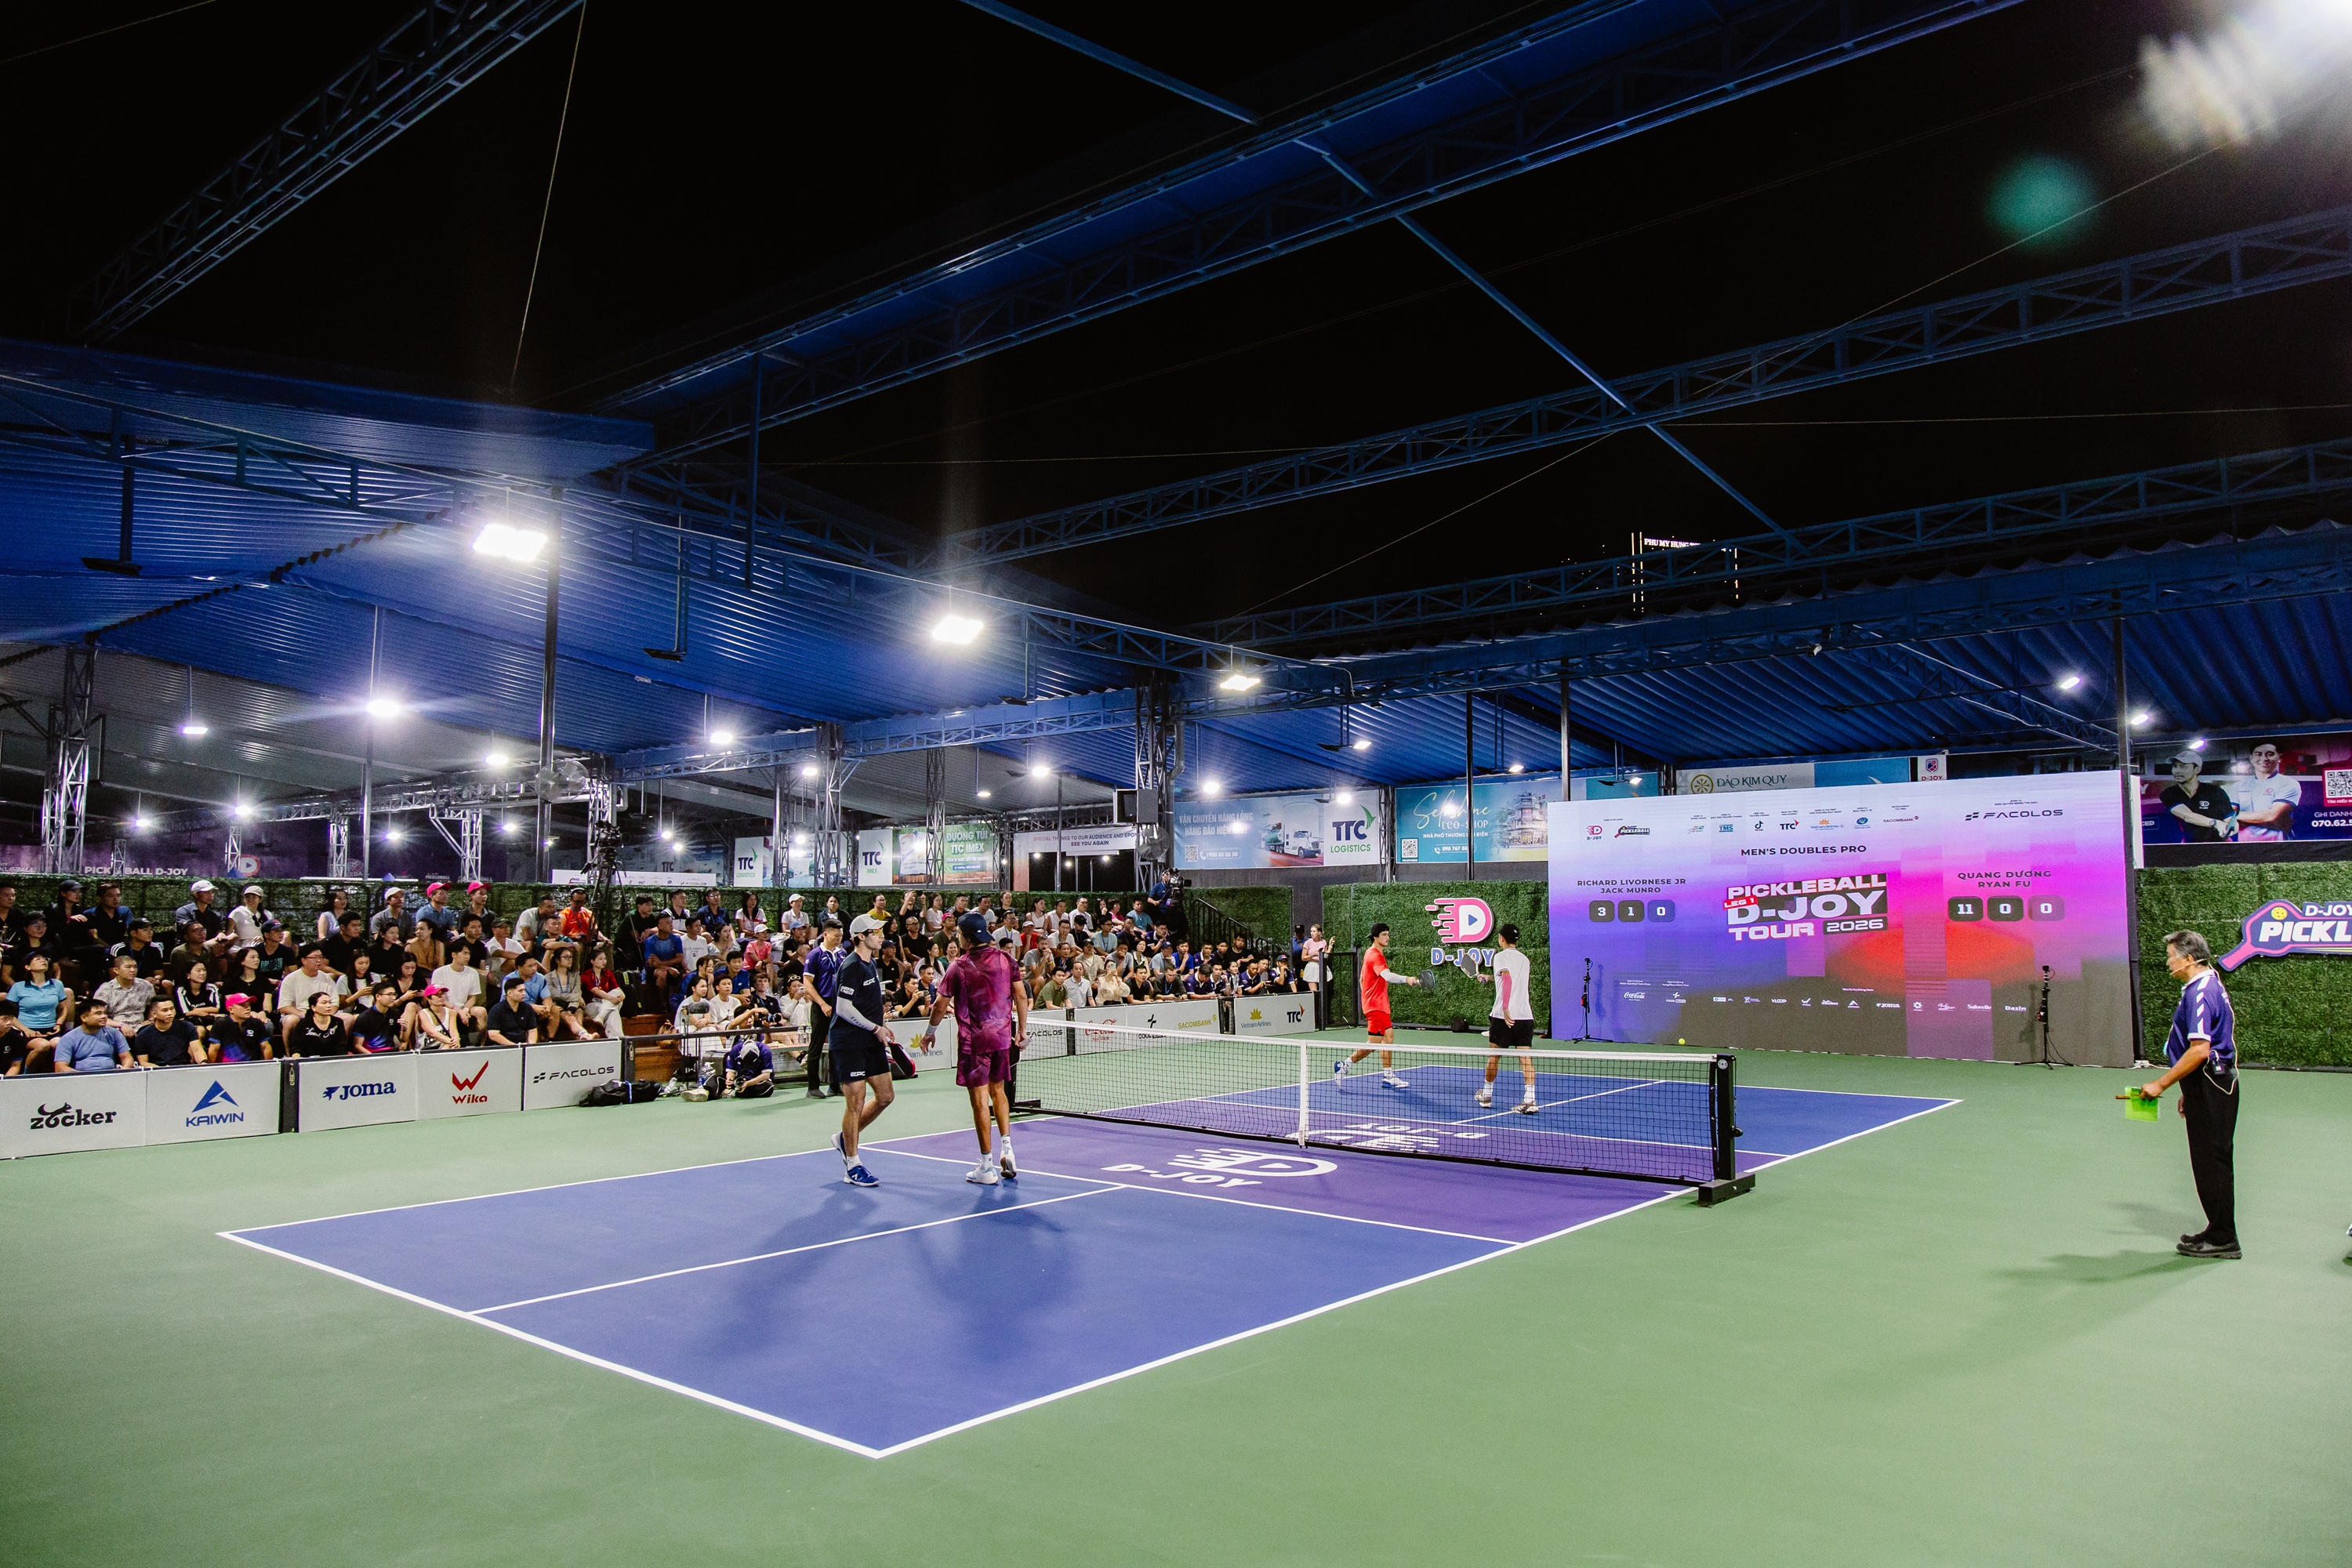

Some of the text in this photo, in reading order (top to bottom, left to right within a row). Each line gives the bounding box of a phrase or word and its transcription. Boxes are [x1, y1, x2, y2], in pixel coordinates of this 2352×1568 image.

[1717, 775, 1787, 788] ĐẢO KIM QUY
[1983, 809, 2063, 818] FACOLOS
[1332, 819, 1367, 841] TTC
[950, 842, 985, 854] TTC IMEX
[1330, 844, 1371, 853] LOGISTICS
[1741, 848, 1777, 856] MEN'S
[1780, 846, 1837, 855] DOUBLES
[737, 857, 754, 870] TTC
[862, 851, 882, 866] TTC
[662, 861, 674, 872] TTC
[1958, 869, 2052, 880] QUANG DƯƠNG
[1728, 873, 1886, 899] PICKLEBALL
[1724, 898, 1747, 908] LEG
[1728, 890, 1886, 925] D-JOY
[1957, 902, 2053, 914] 11 0 0
[1597, 906, 1666, 916] 3 1 0
[1728, 918, 1884, 941] TOUR 2026
[1431, 948, 1495, 967] D-JOY
[1287, 1011, 1301, 1023] TTC
[1178, 1019, 1212, 1029] SACOMBANK
[549, 1066, 615, 1080] FACOLOS
[452, 1094, 488, 1105] Wika
[186, 1112, 244, 1127] KAIWIN
[1100, 1163, 1263, 1188] D-JOY
